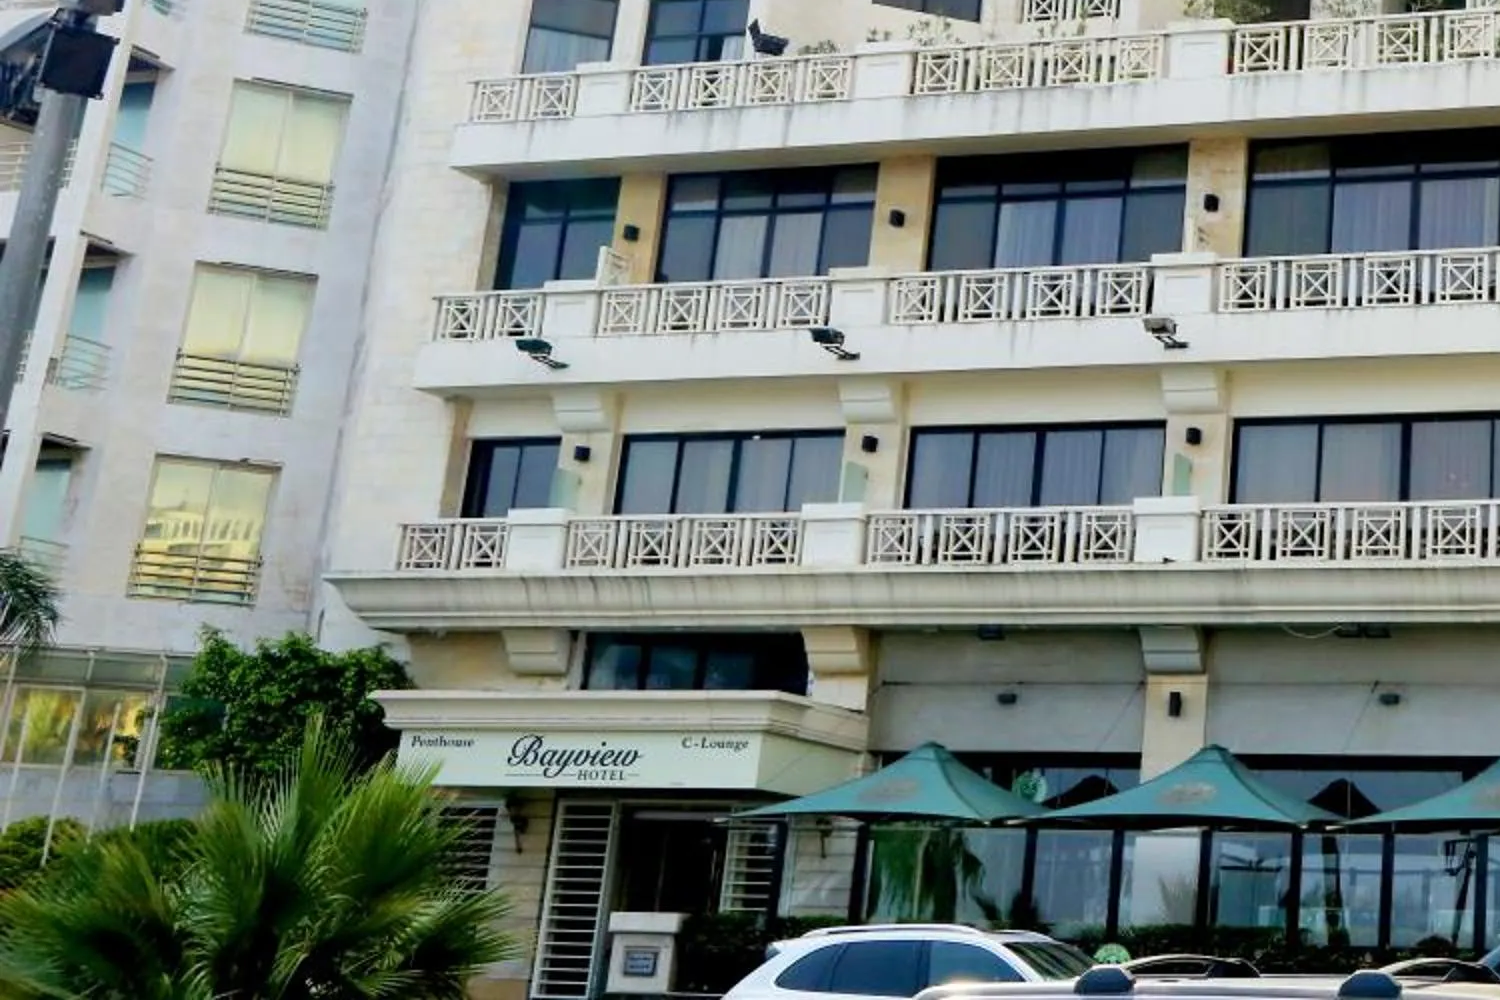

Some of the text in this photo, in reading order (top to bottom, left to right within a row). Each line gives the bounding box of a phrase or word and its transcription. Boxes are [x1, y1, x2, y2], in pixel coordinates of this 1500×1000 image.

[411, 735, 475, 748] Penthouse
[507, 734, 643, 778] Bayview
[577, 769, 628, 781] HOTEL
